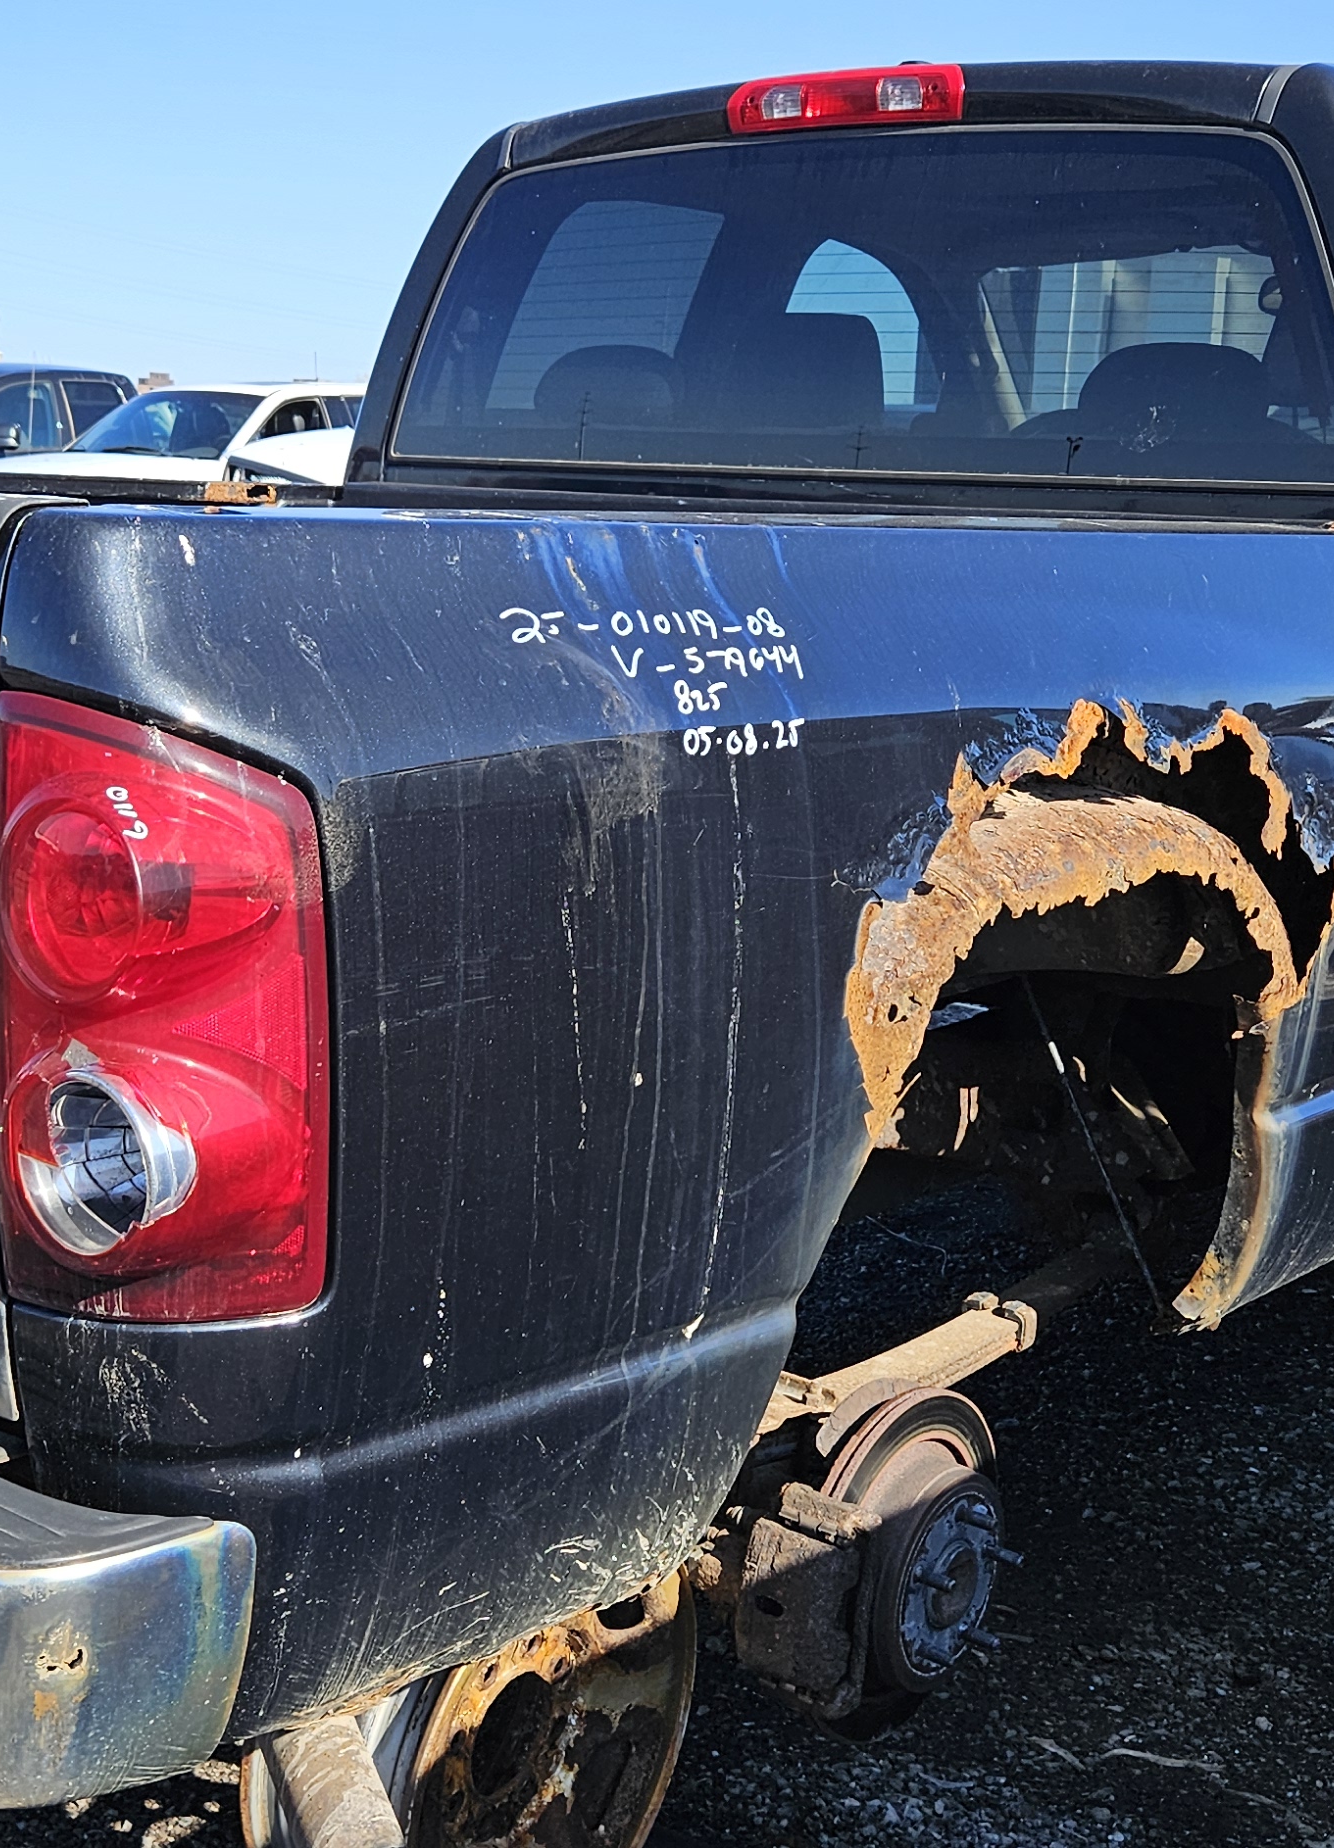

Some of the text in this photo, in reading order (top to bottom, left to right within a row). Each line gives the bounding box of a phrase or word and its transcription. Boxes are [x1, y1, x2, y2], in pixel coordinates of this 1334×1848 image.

[674, 682, 727, 714] 825
[684, 718, 805, 755] 05.08.25
[105, 786, 149, 840] 0119
